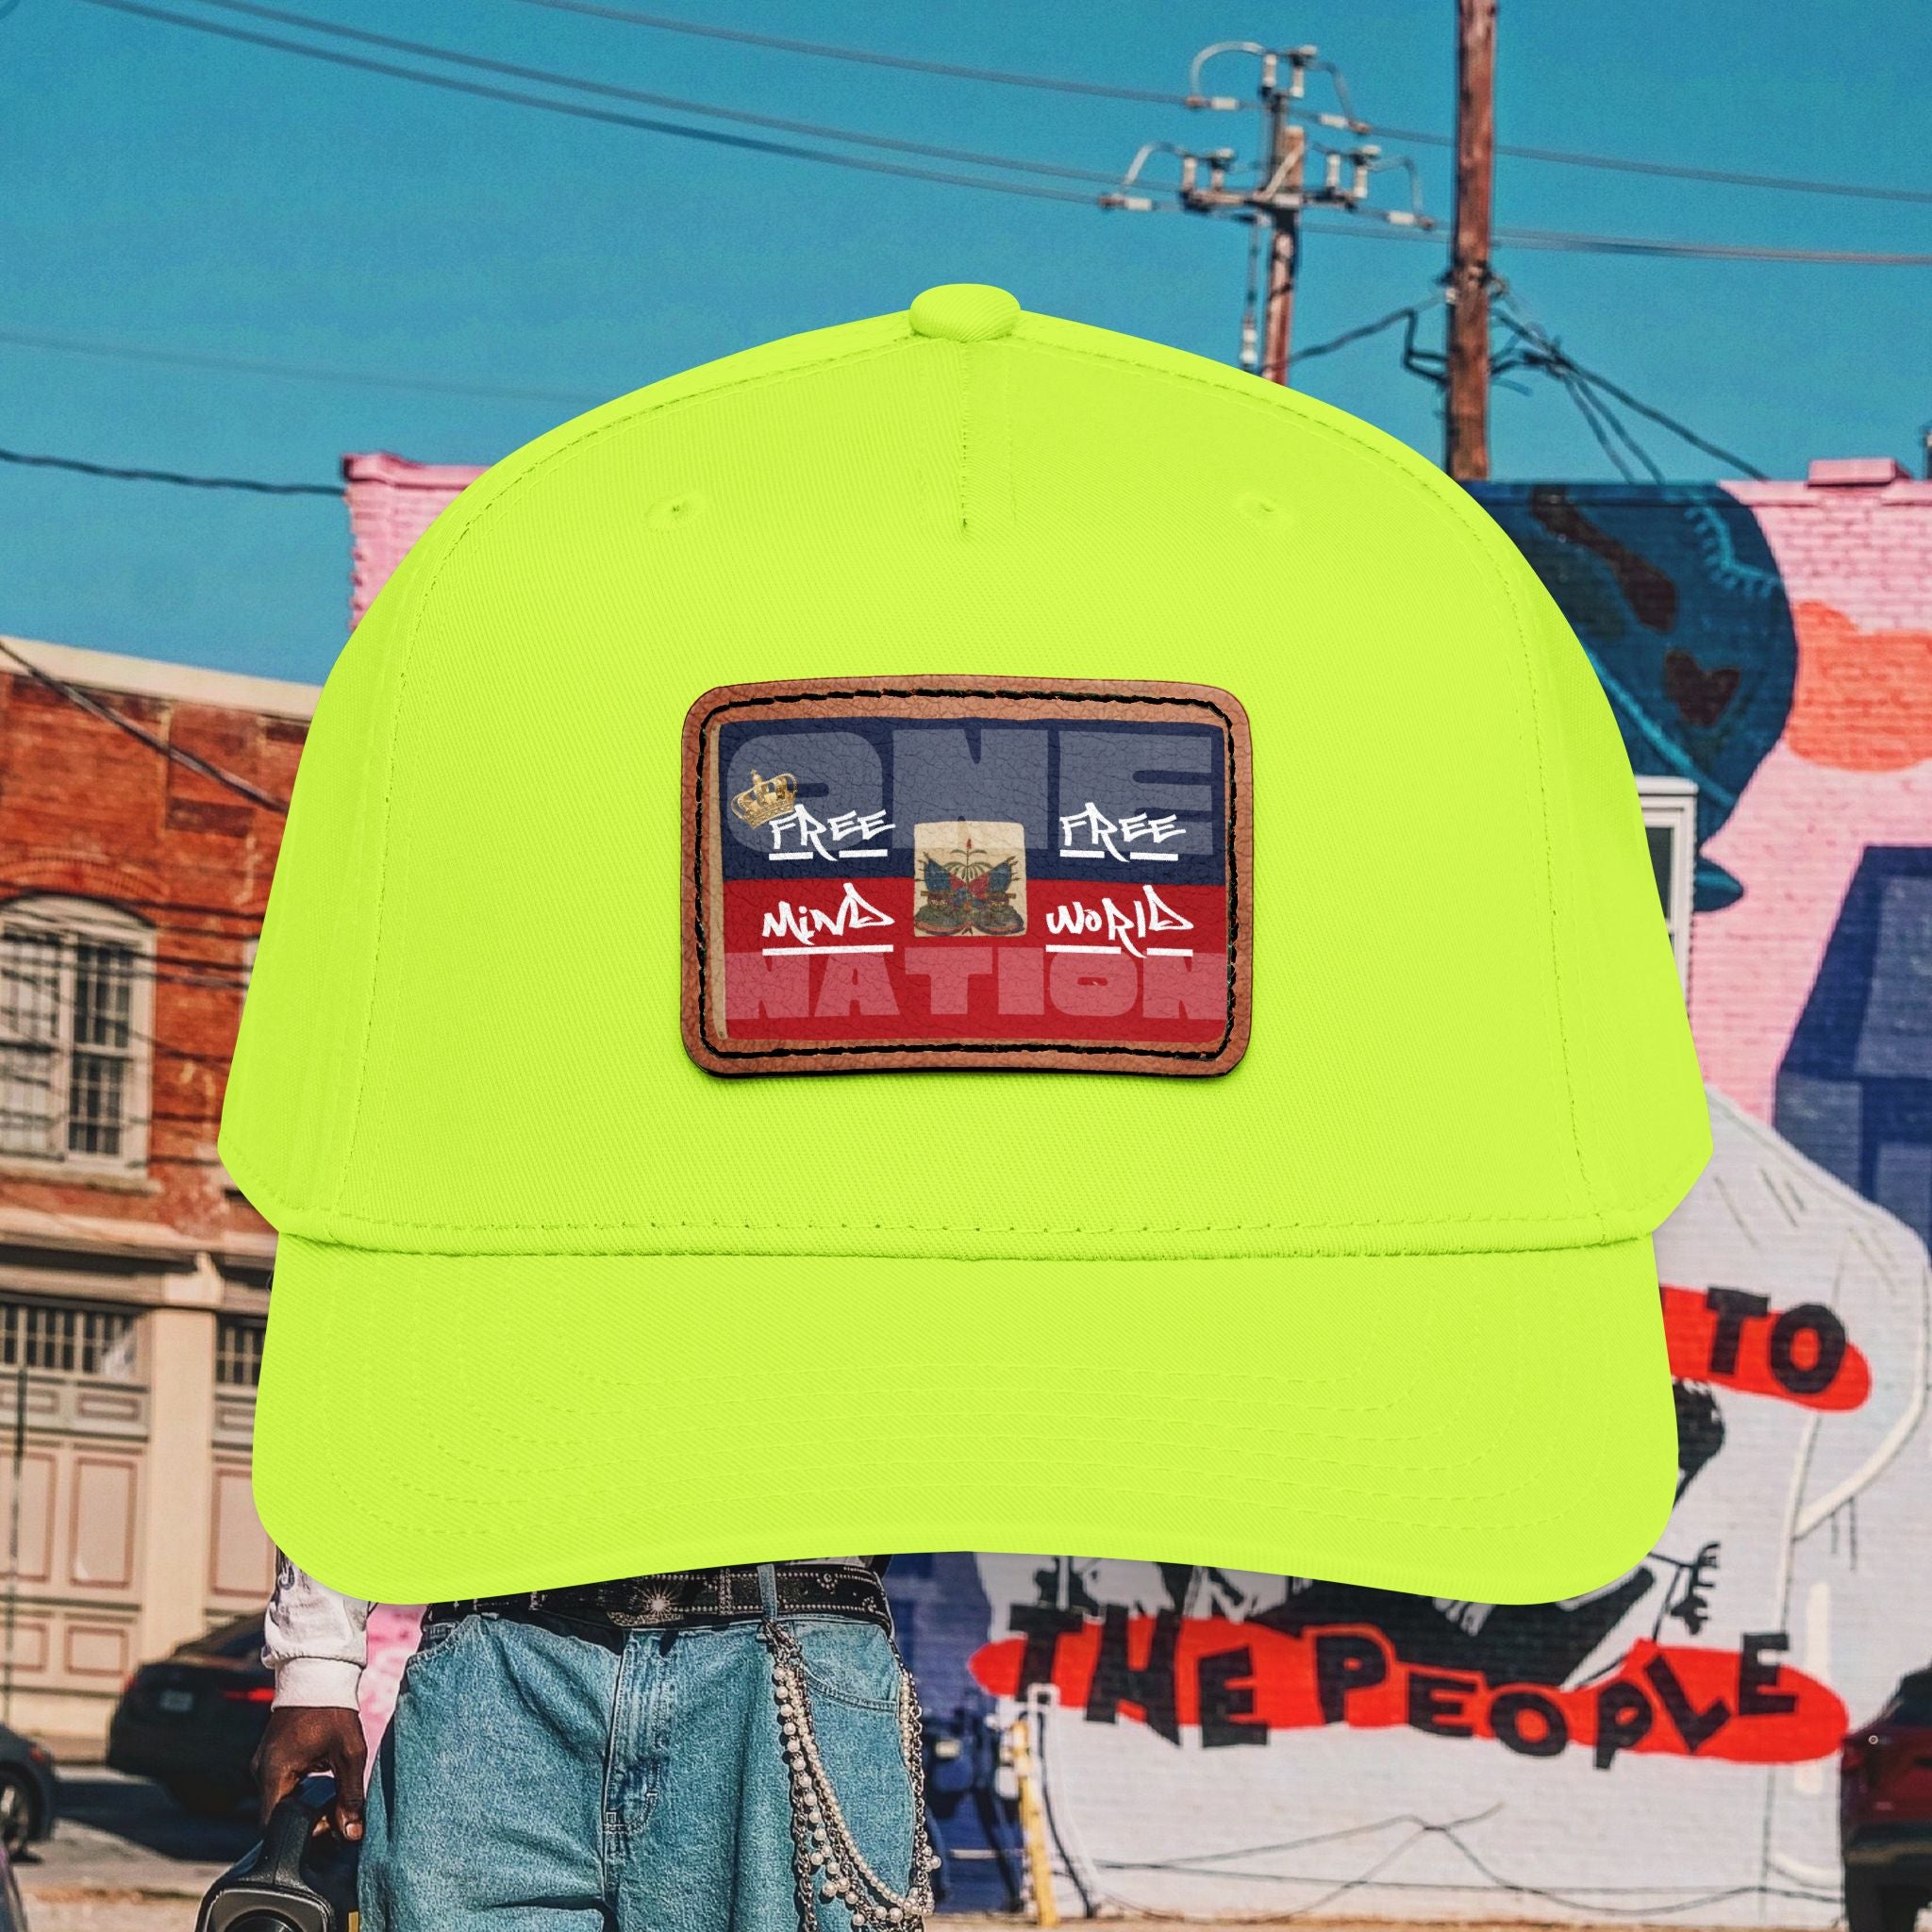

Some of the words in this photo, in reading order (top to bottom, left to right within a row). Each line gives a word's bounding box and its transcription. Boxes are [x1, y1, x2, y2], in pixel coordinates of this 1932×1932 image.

[728, 729, 1213, 855] ONE
[771, 804, 896, 860] FREE
[1059, 802, 1186, 862] FREE
[724, 946, 1226, 1021] NATION
[1707, 1287, 1847, 1395] TO
[1009, 1604, 1268, 1749] THE
[1314, 1631, 1800, 1770] PEOPLE
